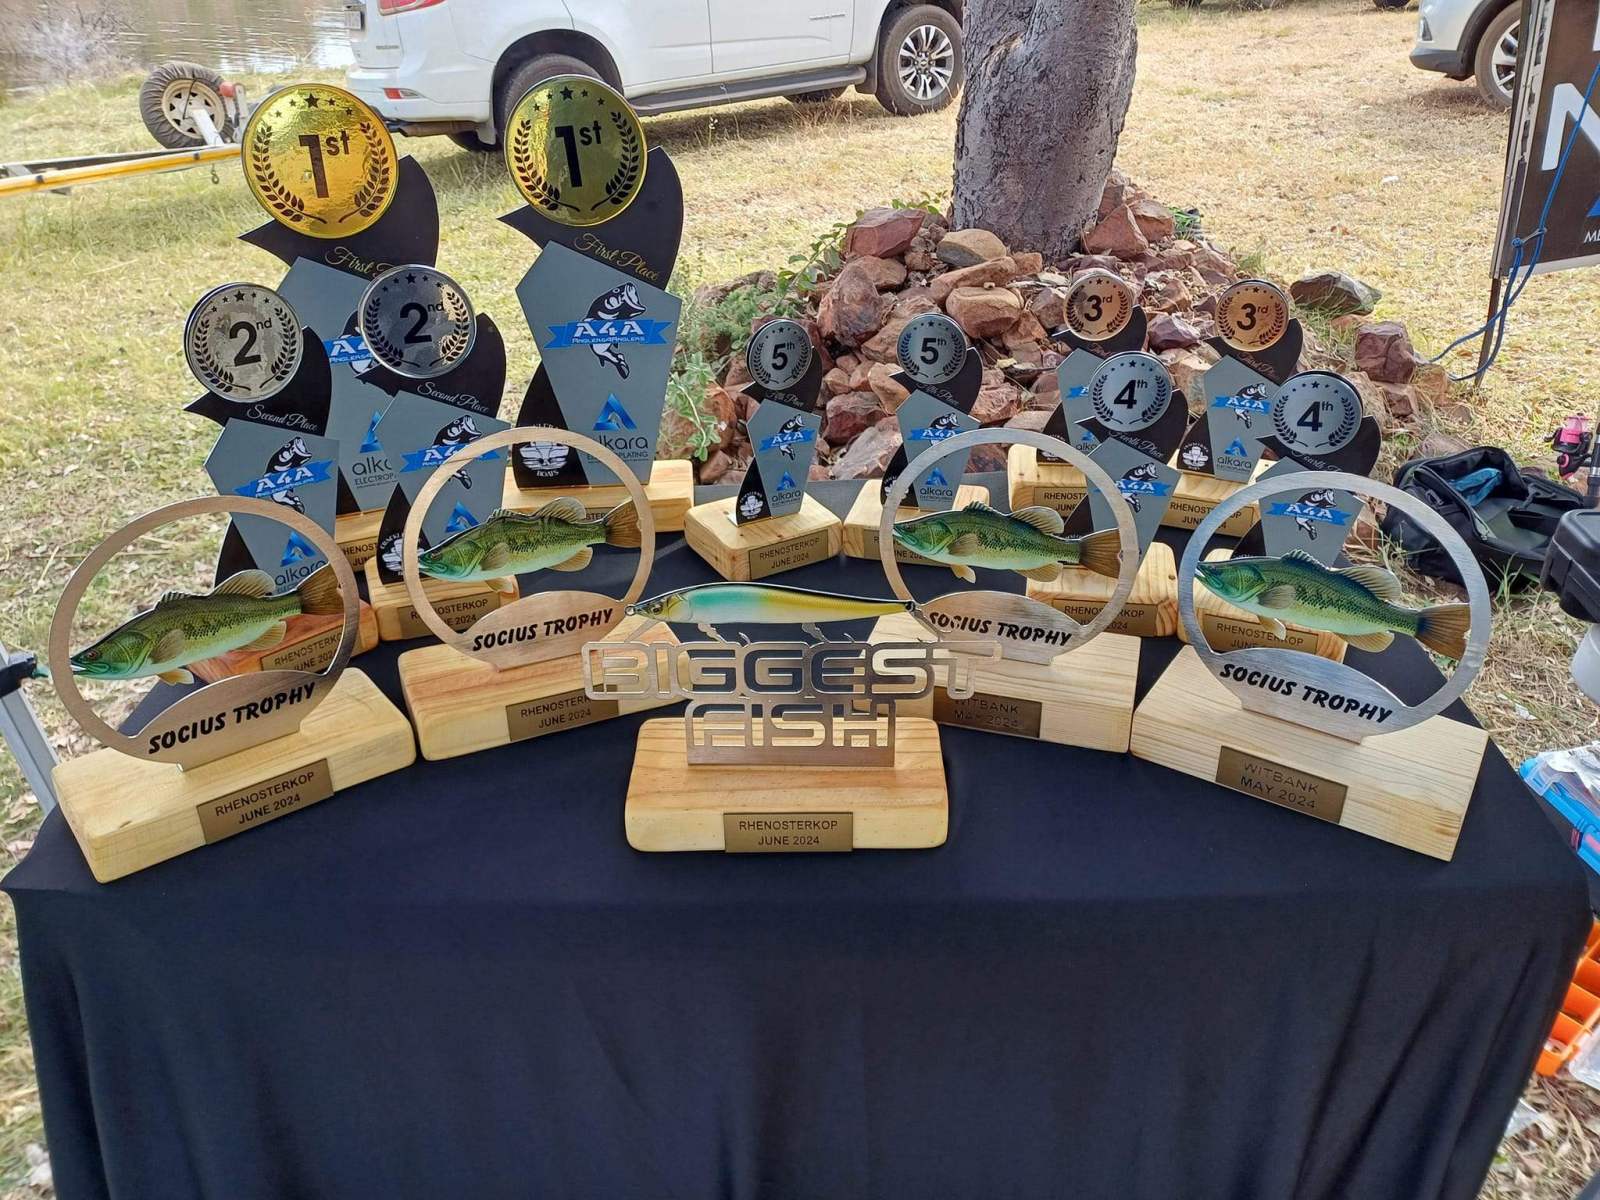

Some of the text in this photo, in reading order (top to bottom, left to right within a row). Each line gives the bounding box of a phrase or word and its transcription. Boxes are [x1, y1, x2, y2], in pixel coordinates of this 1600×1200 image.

[298, 130, 350, 199] 1st
[554, 120, 602, 188] 1st
[573, 232, 658, 281] First Place
[399, 302, 445, 345] 2nd
[1084, 295, 1113, 322] 3rd
[1236, 302, 1269, 331] 3rd
[229, 317, 272, 367] 2nd
[573, 320, 644, 337] A4A
[771, 340, 796, 371] 5th
[920, 337, 947, 365] 5th
[416, 381, 489, 413] Second Place
[1113, 379, 1148, 410] 4th
[246, 404, 318, 431] Second Place
[1296, 401, 1334, 432] 4th
[598, 435, 648, 449] lkara
[256, 466, 314, 493] A4A
[354, 472, 394, 486] ELECTROP
[1044, 492, 1087, 501] RHENOST
[352, 556, 370, 567] JUN
[771, 552, 809, 569] JUNE 2024
[455, 614, 476, 625] 2024
[472, 608, 614, 652] SOCIUS TROPHY
[929, 612, 1073, 647] SOCIUS TROPHY
[274, 632, 342, 666] RHENOSTERKO
[1231, 639, 1256, 648] JUN
[582, 641, 1000, 700] BIGGEST
[520, 694, 592, 719] RHENOSTERK
[1219, 663, 1393, 723] SOCIUS TROPHY
[148, 681, 316, 755] SOCIUS TROPHY
[538, 708, 592, 729] JUNE 2024
[685, 700, 896, 750] FISH
[1240, 775, 1316, 809] MAY 2024
[1242, 761, 1320, 795] WITBANK
[214, 771, 316, 817] RHENOSTERKOP
[238, 793, 301, 825] JUNE 2024
[738, 820, 838, 831] RHENOSTERKOP
[758, 835, 820, 846] JUNE 2024
